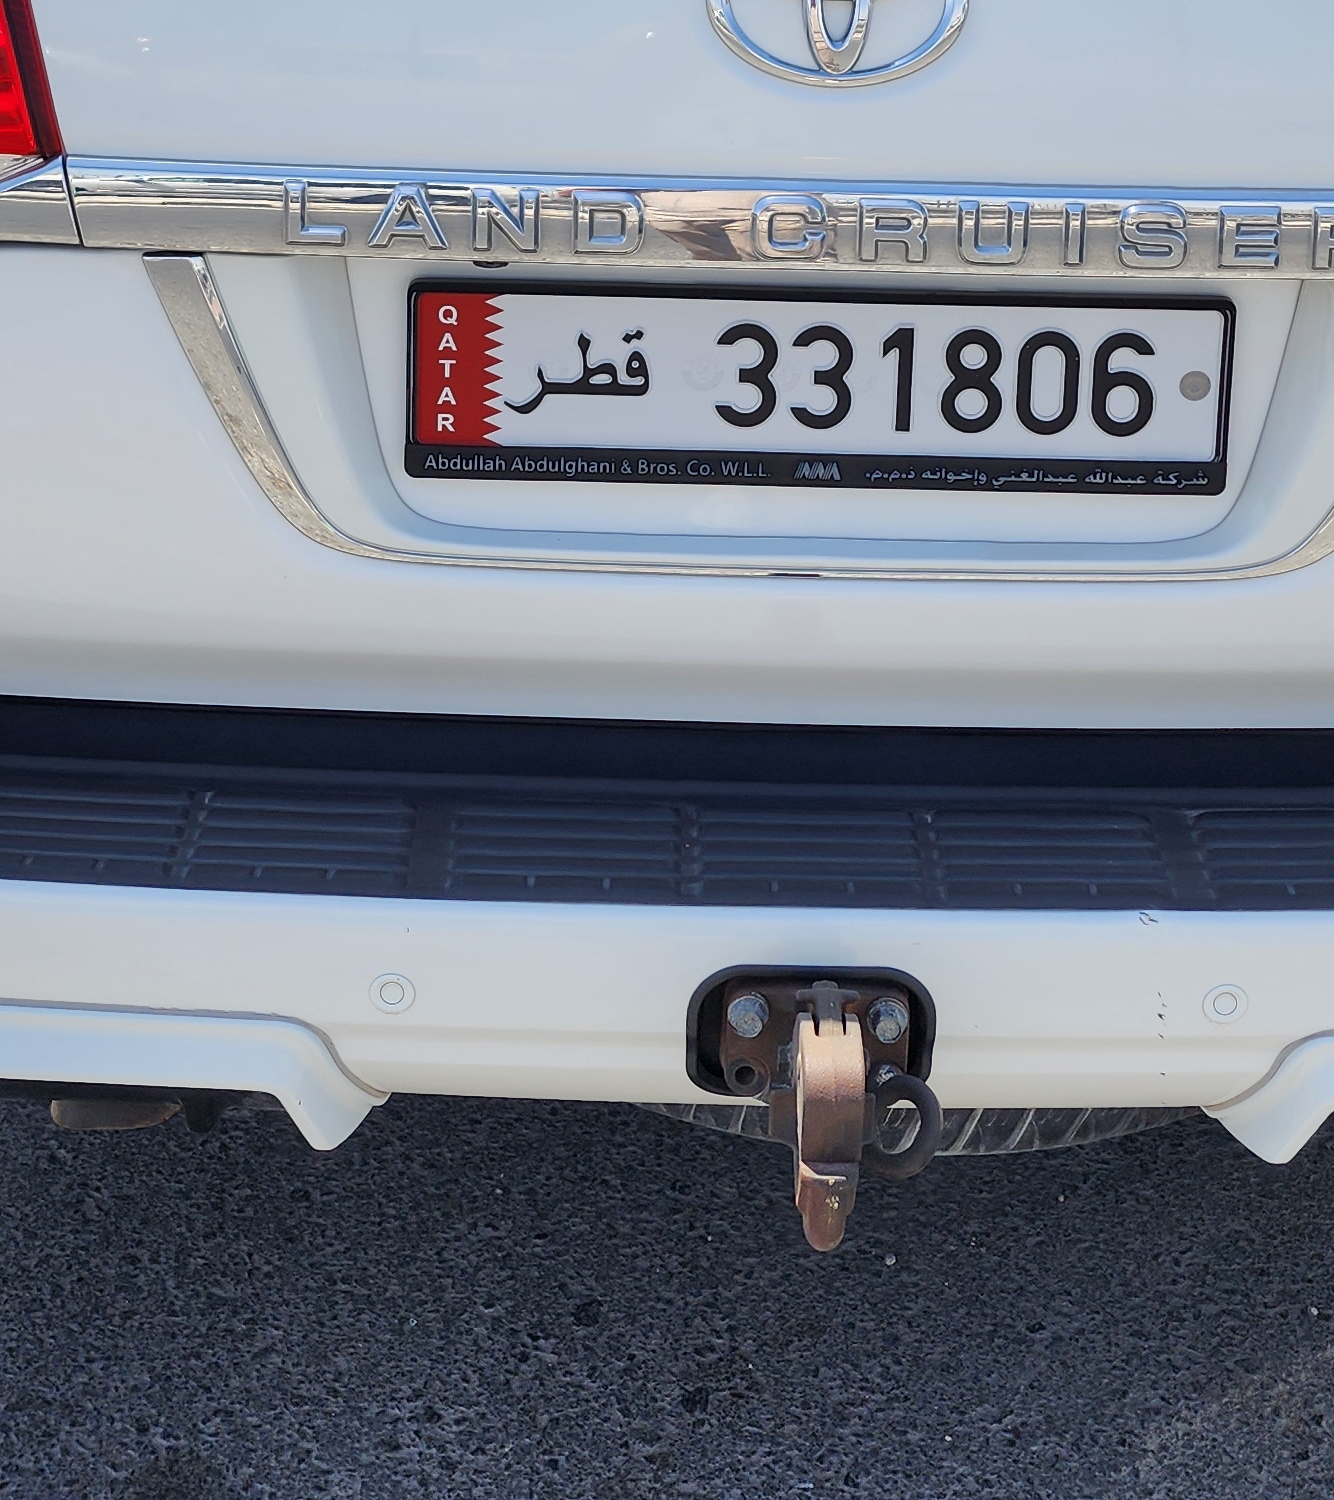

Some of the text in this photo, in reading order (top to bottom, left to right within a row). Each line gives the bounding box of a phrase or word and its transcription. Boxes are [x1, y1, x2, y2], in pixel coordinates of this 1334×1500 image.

[283, 179, 646, 256] LAND
[436, 305, 458, 433] QATAR
[503, 328, 650, 415] قطر
[714, 322, 1156, 436] 331806
[424, 455, 772, 478] Abdullah Abdulghani & Bros. Co. W.L.L.
[992, 469, 1078, 489] عبدالغني
[1084, 468, 1147, 487] عبدالله
[1153, 470, 1209, 487] شركة
